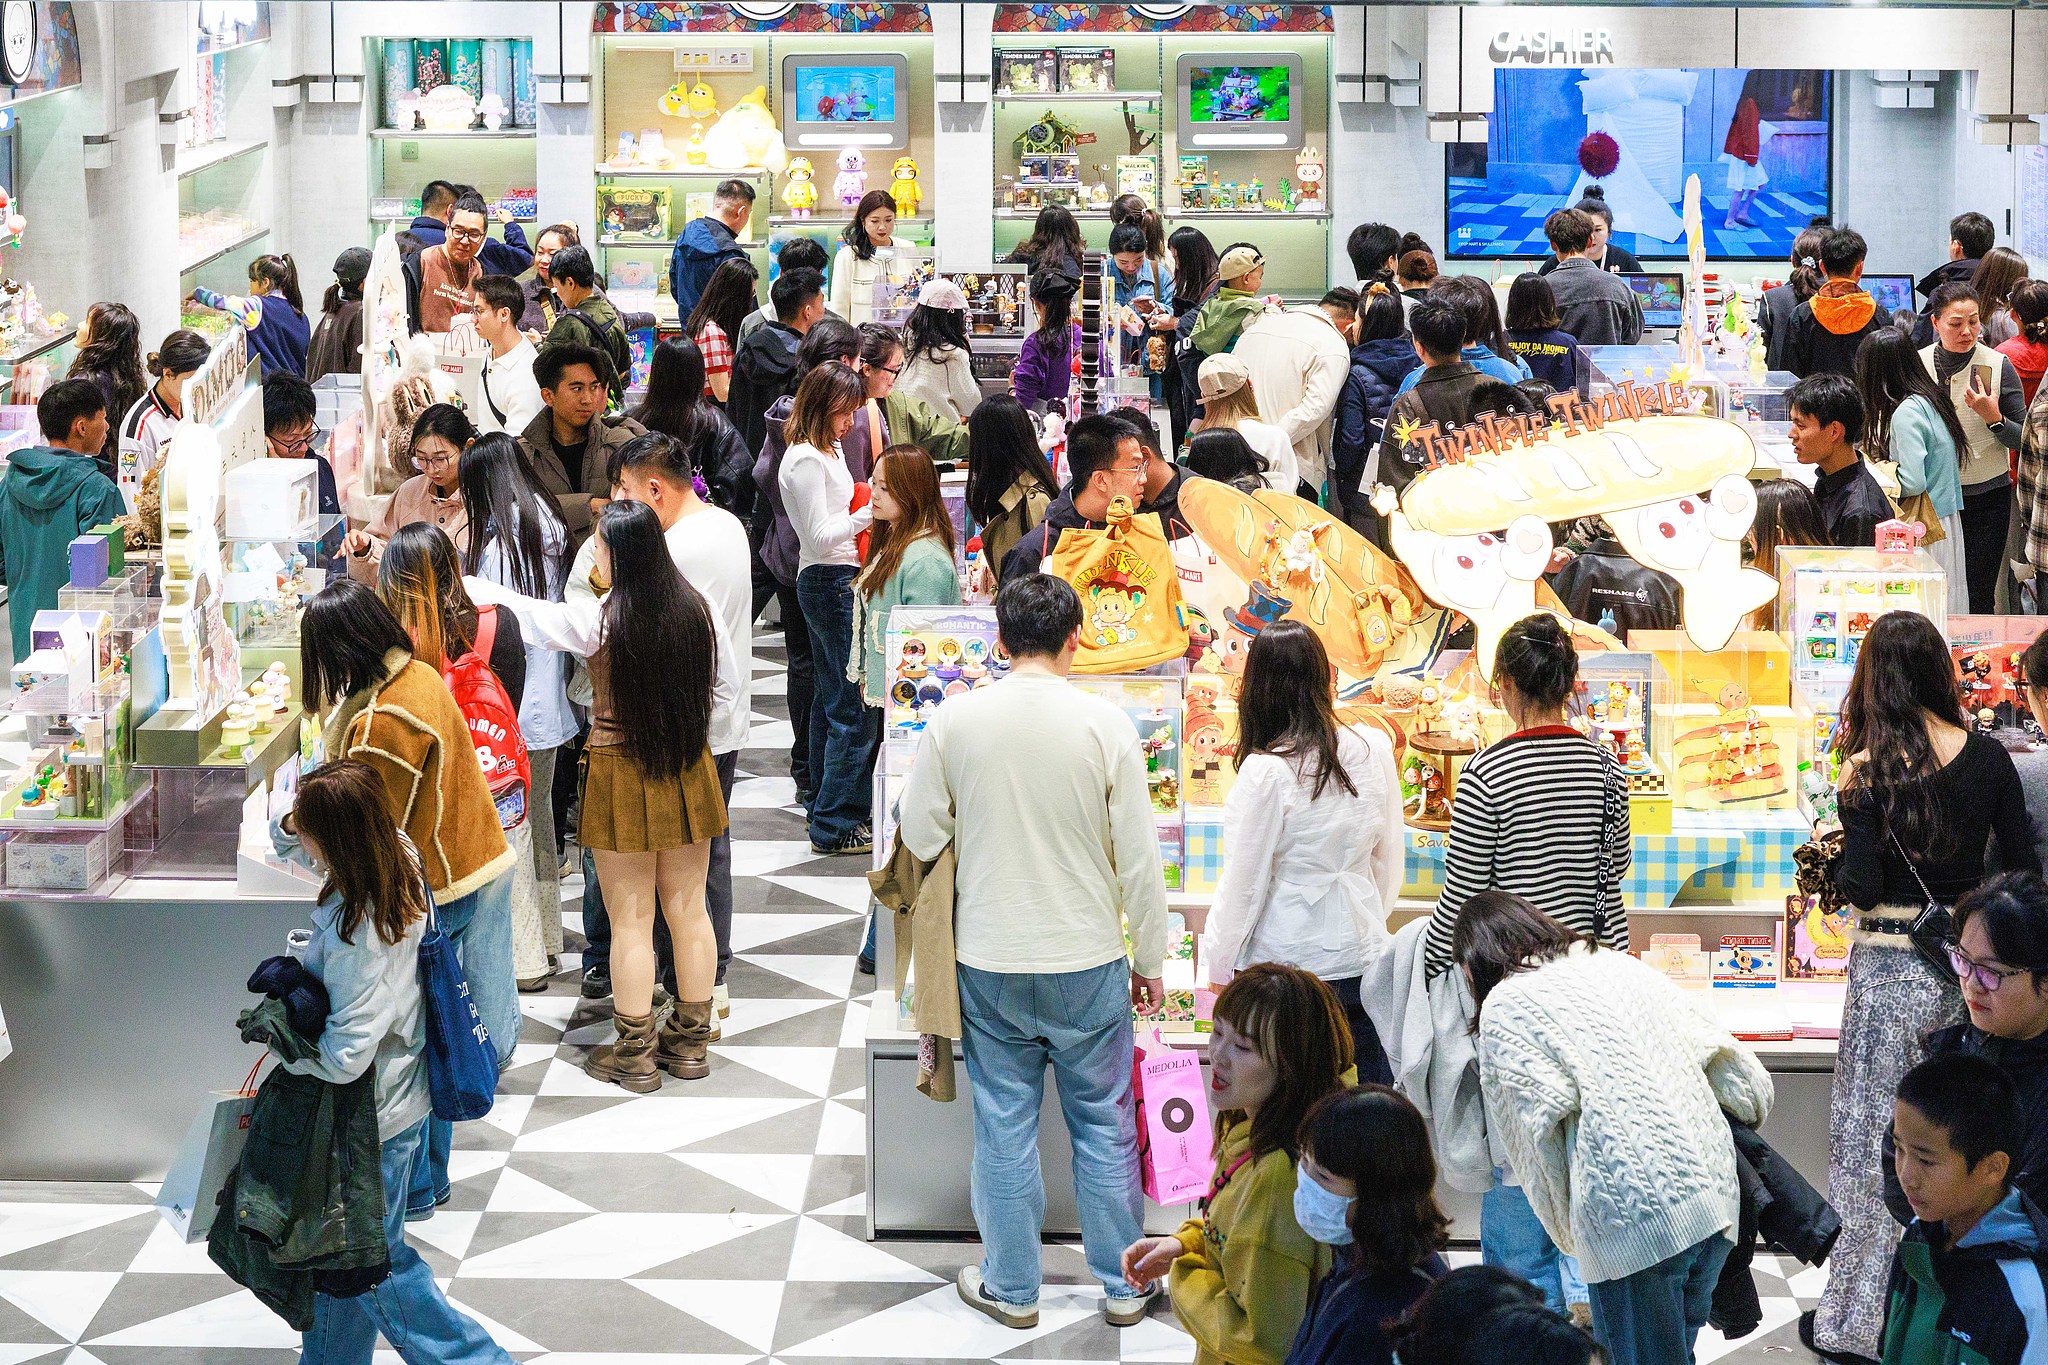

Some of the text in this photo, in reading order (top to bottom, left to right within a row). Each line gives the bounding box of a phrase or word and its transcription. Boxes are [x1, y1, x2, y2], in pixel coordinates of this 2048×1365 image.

[1491, 26, 1614, 55] CASHIER
[1508, 342, 1531, 350] ENJOY
[1543, 344, 1569, 354] MONEY
[191, 332, 246, 424] DIMOO
[1408, 379, 1690, 472] TWINKLE TWINKLE
[1073, 549, 1158, 598] TWNKLE
[1592, 588, 1635, 597] RESHAKE
[936, 621, 987, 630] ROMANTIC
[470, 718, 507, 742] UMEN
[1147, 1058, 1193, 1076] MEDOLIA
